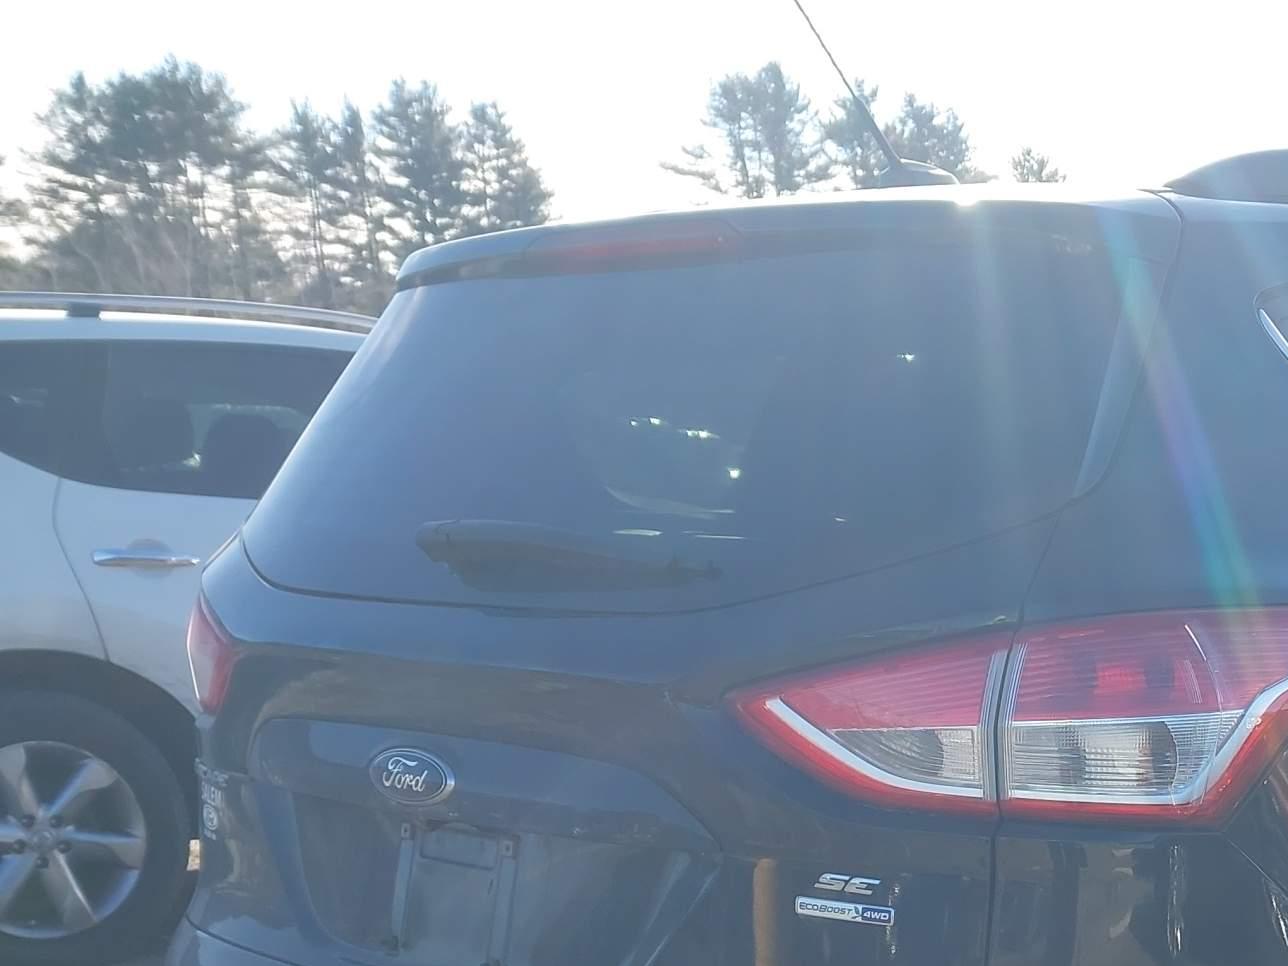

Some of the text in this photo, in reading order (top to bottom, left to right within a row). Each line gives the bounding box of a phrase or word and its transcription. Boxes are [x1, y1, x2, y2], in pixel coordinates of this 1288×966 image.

[382, 756, 428, 792] Ford
[814, 873, 881, 896] SE
[863, 910, 890, 921] 4WD
